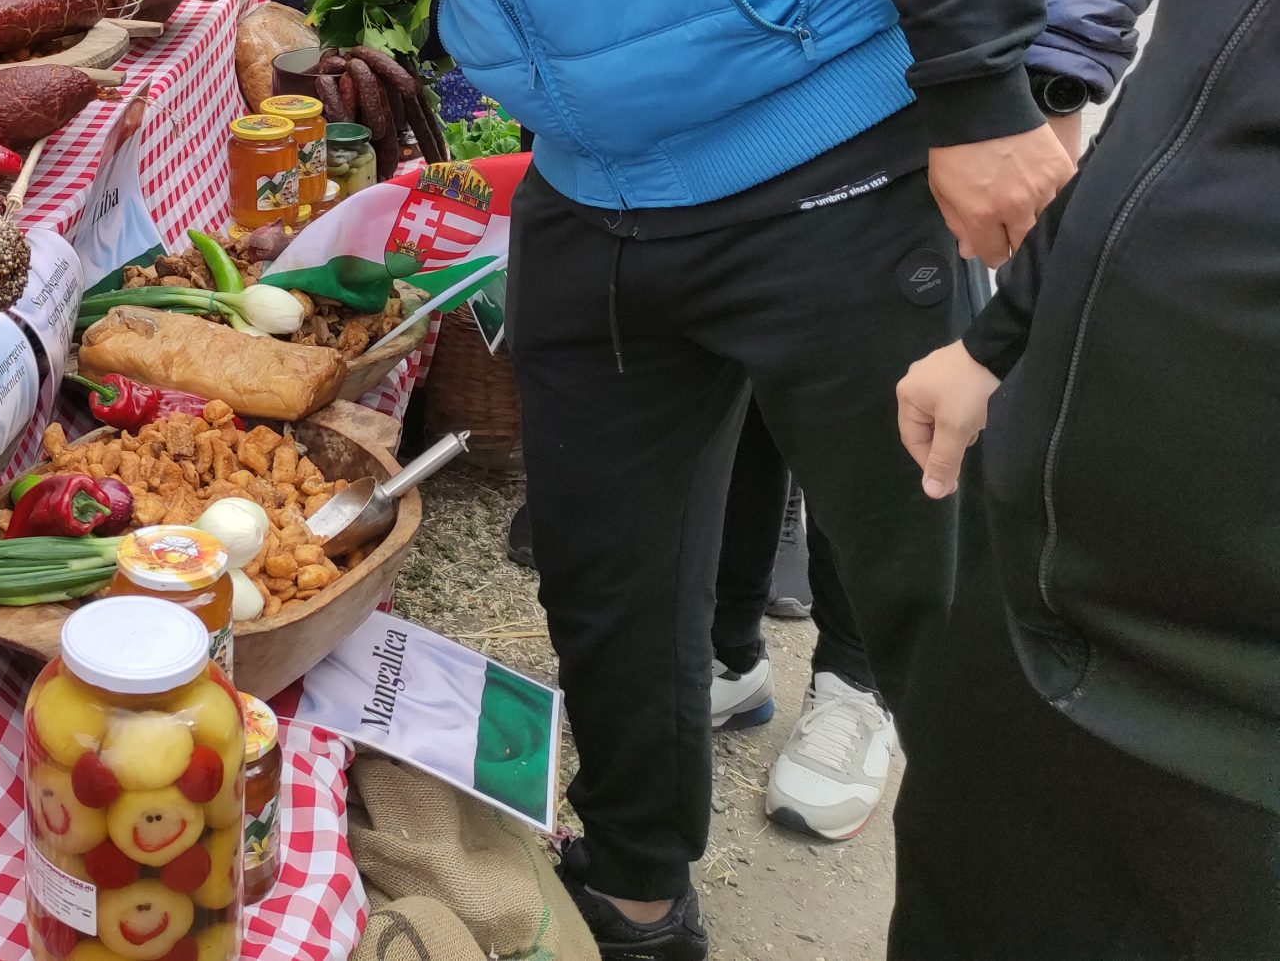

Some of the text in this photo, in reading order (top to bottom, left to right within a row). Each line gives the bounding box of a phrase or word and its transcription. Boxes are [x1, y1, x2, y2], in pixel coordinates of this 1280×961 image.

[91, 188, 119, 226] Liba
[816, 176, 888, 207] umbro since 1924
[916, 278, 941, 294] umbro
[360, 629, 408, 735] Mangalica
